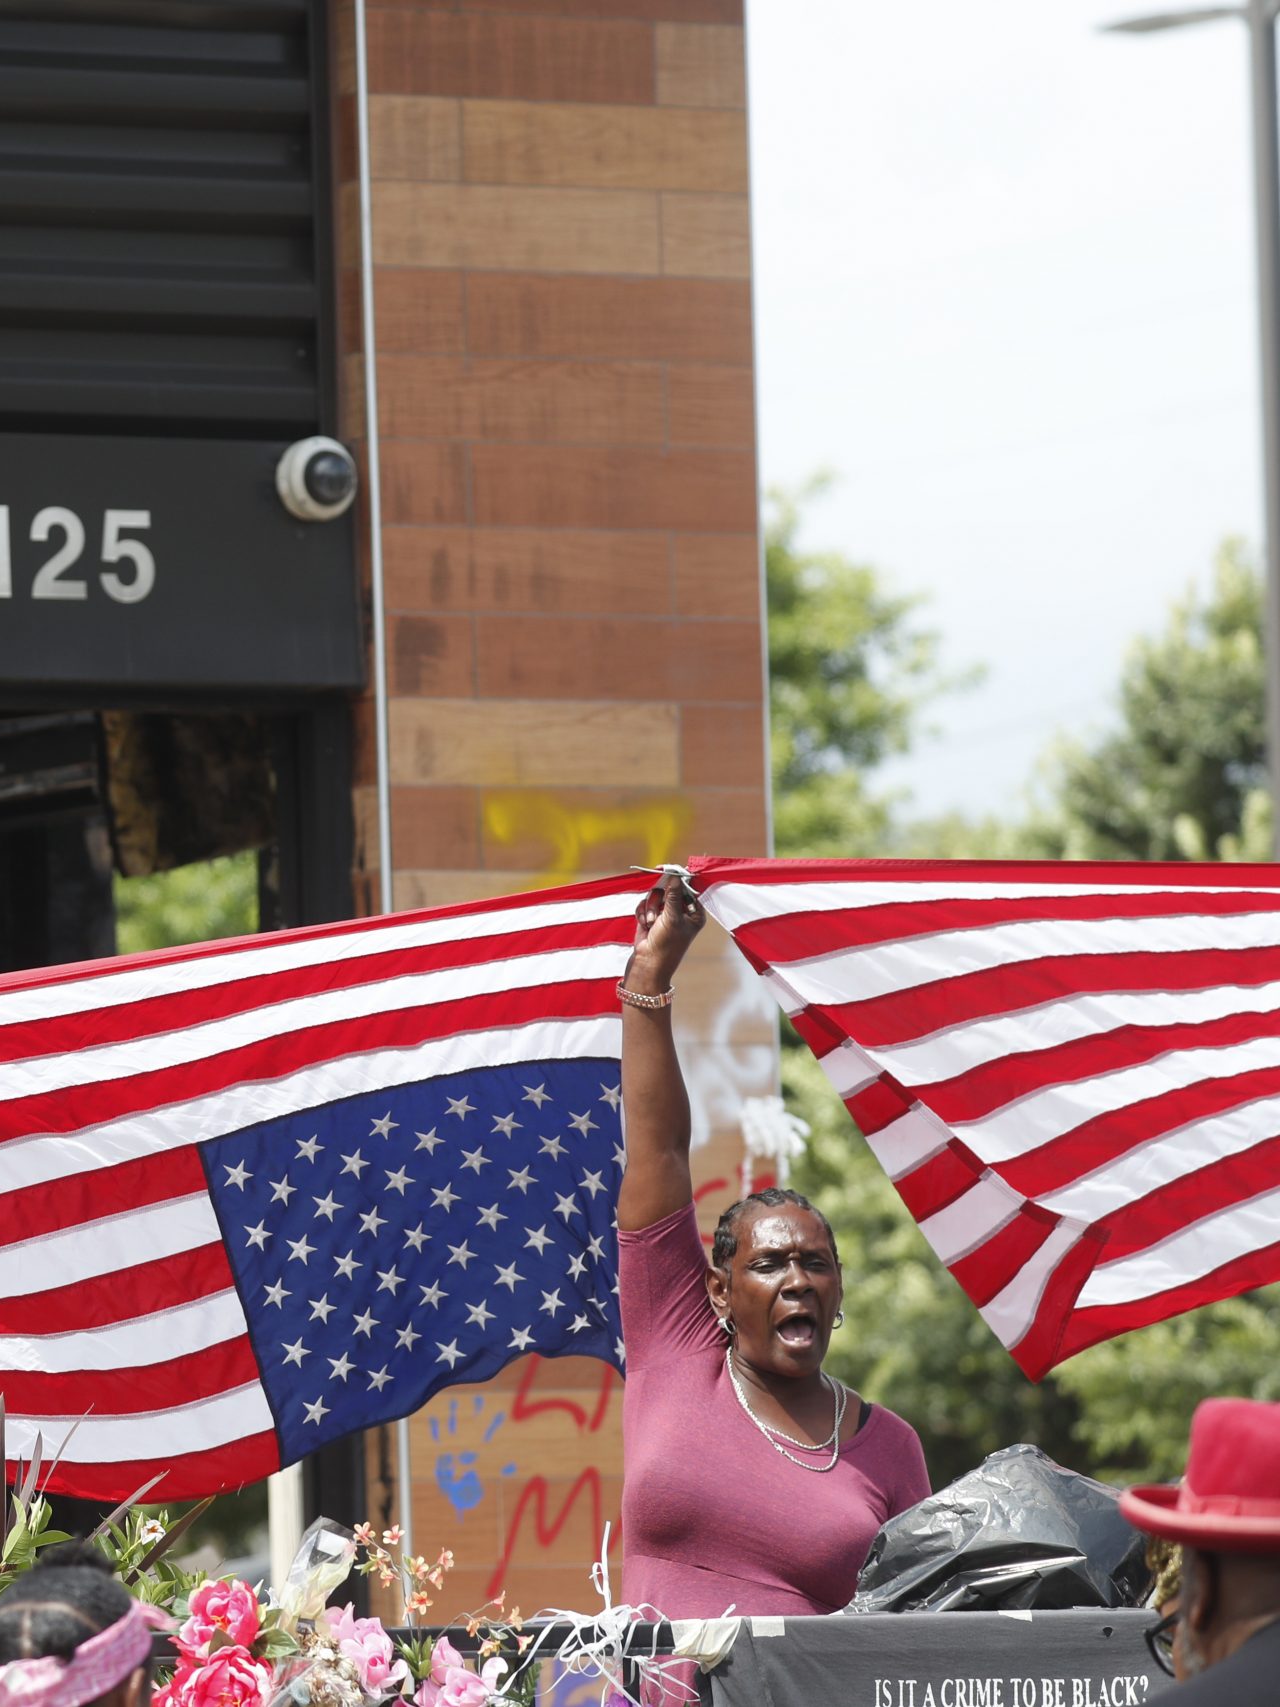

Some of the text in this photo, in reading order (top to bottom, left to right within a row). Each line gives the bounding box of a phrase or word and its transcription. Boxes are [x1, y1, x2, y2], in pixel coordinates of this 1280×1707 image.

[874, 1674, 1149, 1707] IS IT A CRIME TO BE BLACK?
